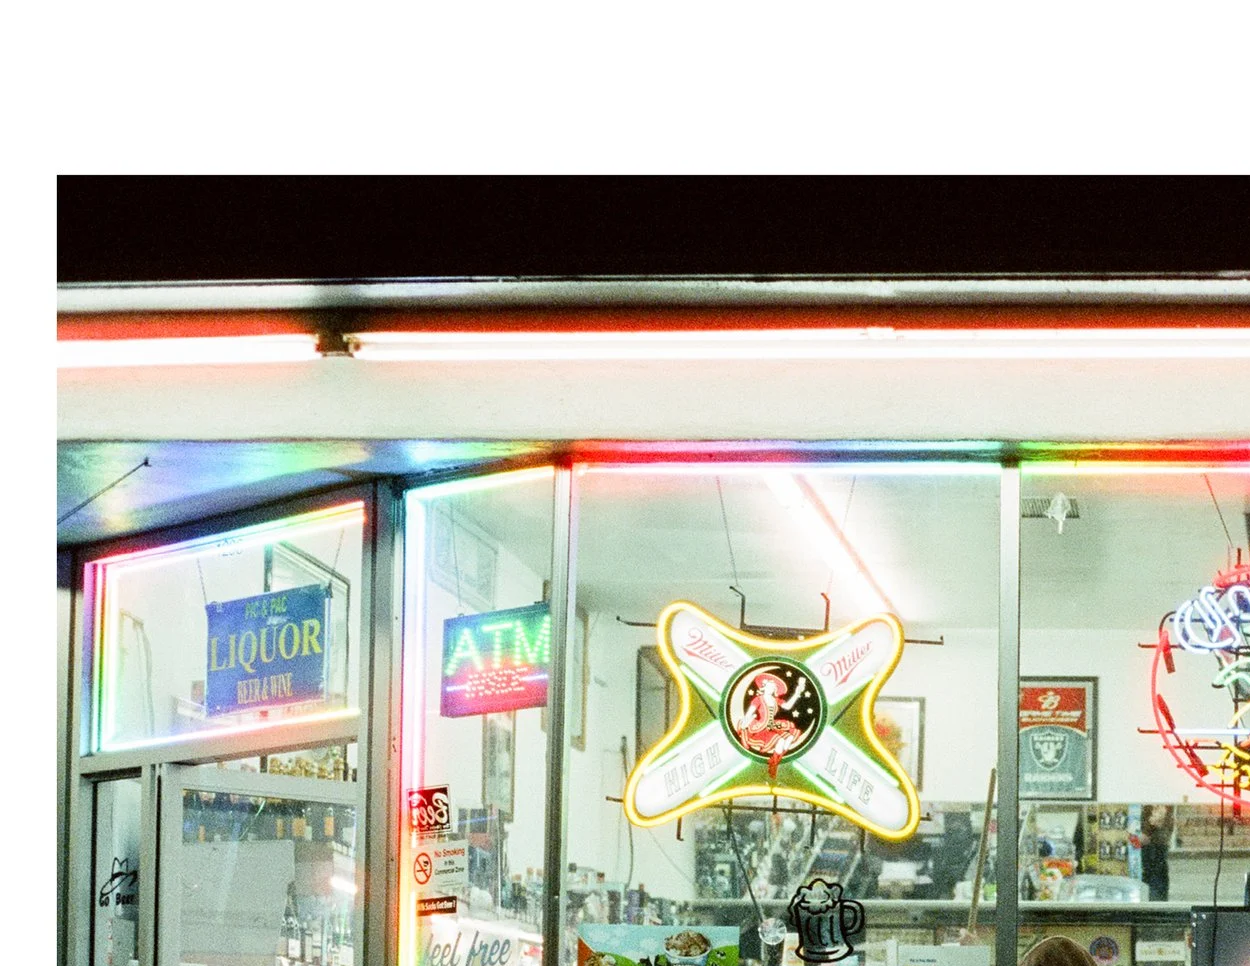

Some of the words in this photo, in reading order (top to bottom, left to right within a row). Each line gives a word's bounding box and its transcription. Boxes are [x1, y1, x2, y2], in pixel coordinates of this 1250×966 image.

[210, 618, 323, 673] LIQUOR
[444, 614, 552, 676] ATM
[687, 627, 736, 671] Miller
[820, 640, 873, 688] Miller
[237, 678, 261, 704] BEER
[262, 676, 269, 700] &
[270, 672, 293, 698] WINE
[663, 742, 724, 798] HIGH
[823, 747, 874, 806] LIFE
